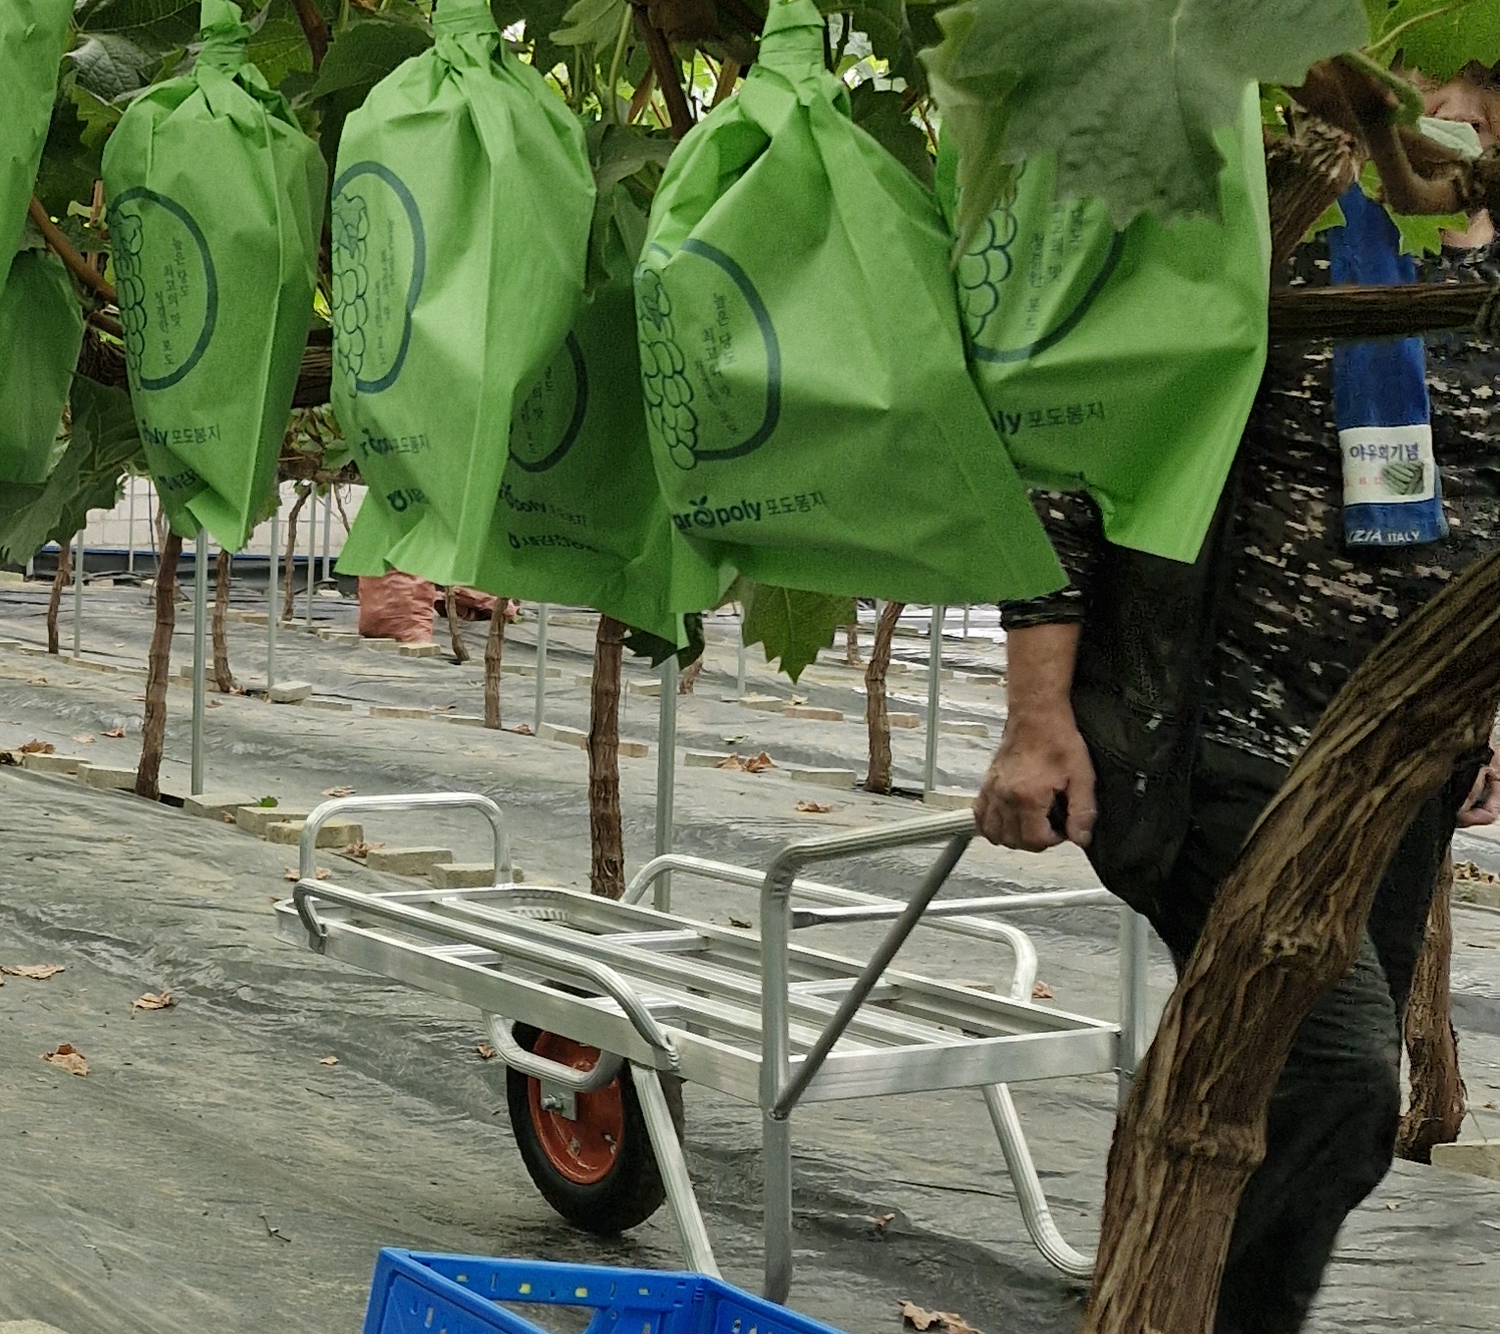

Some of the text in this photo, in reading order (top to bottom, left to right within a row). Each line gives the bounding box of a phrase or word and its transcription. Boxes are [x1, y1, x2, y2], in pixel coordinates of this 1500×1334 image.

[1028, 401, 1105, 427] 포도봉지
[172, 425, 221, 445] 포도봉지
[765, 490, 828, 515] 포도봉지
[1387, 530, 1420, 543] ITALY
